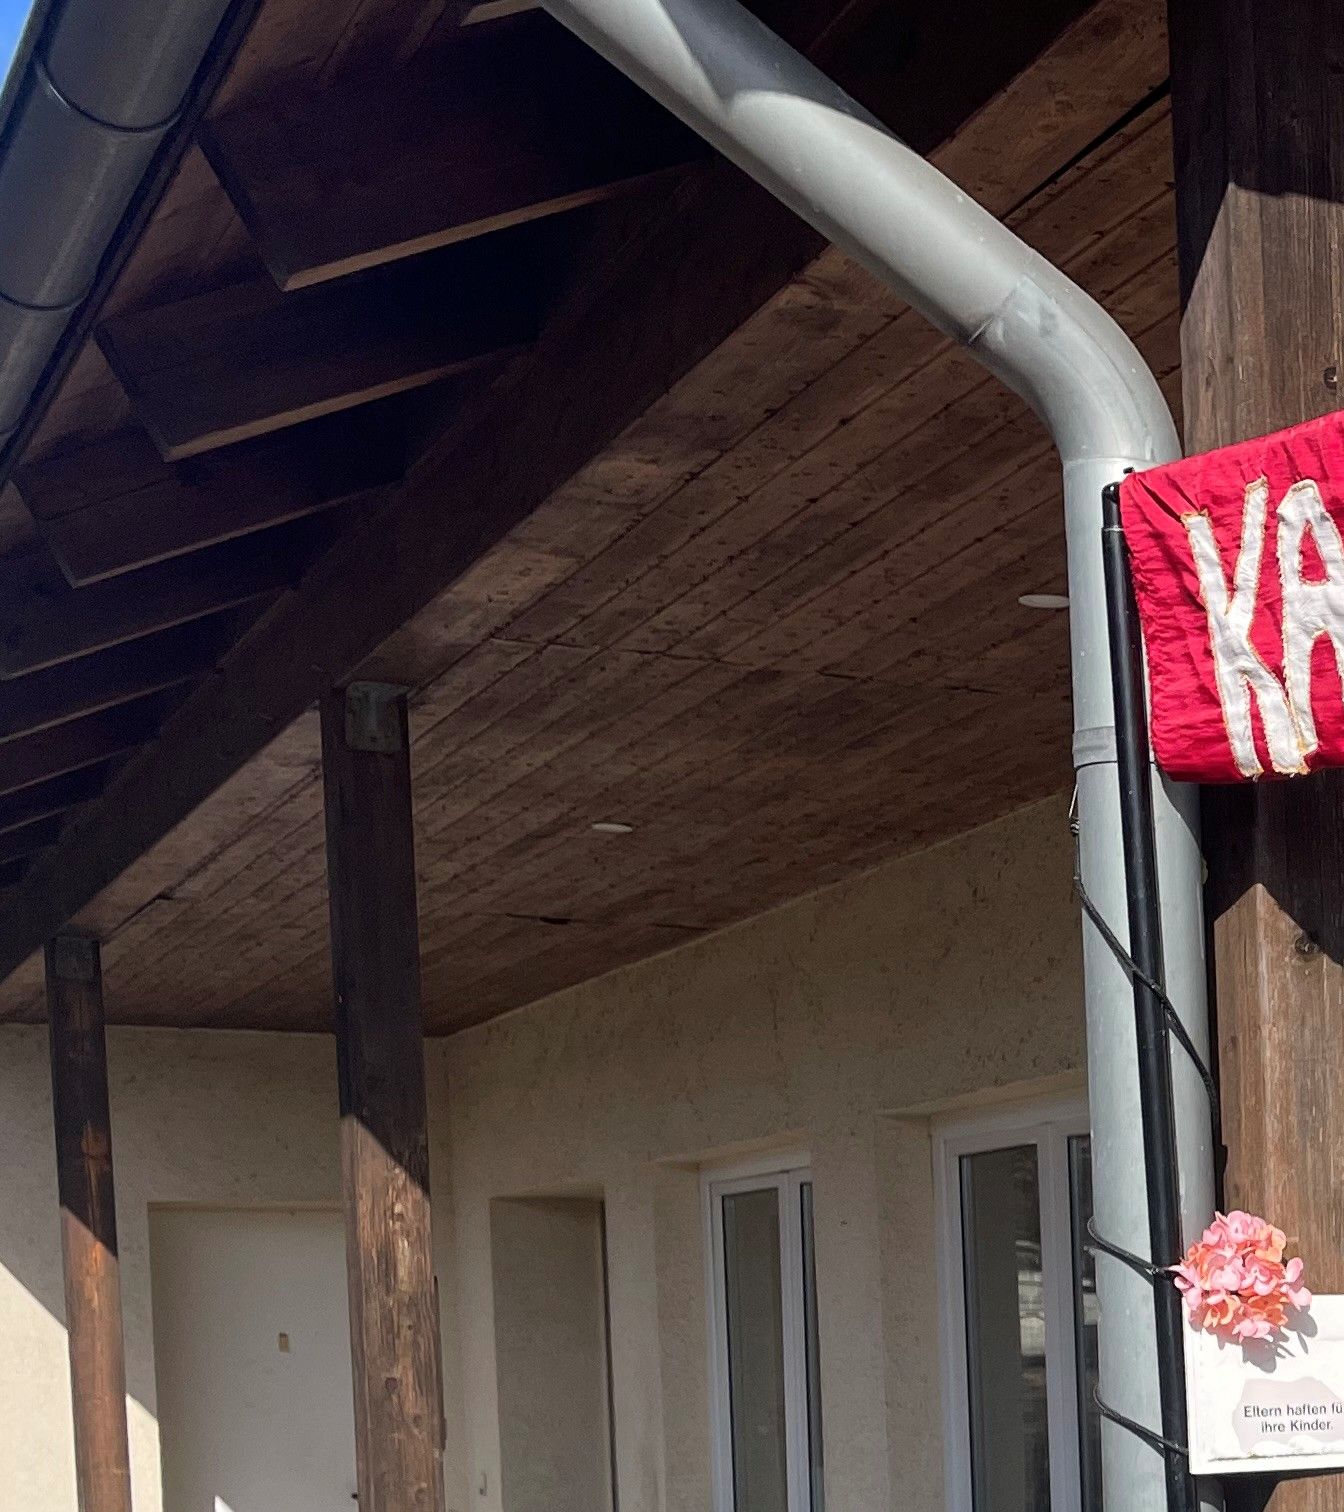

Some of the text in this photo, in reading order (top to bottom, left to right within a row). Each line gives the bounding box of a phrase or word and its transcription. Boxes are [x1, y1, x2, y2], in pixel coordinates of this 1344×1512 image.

[1244, 1404, 1282, 1418] Eltern
[1287, 1403, 1328, 1417] haften
[1261, 1418, 1333, 1433] ihre Kinder.
